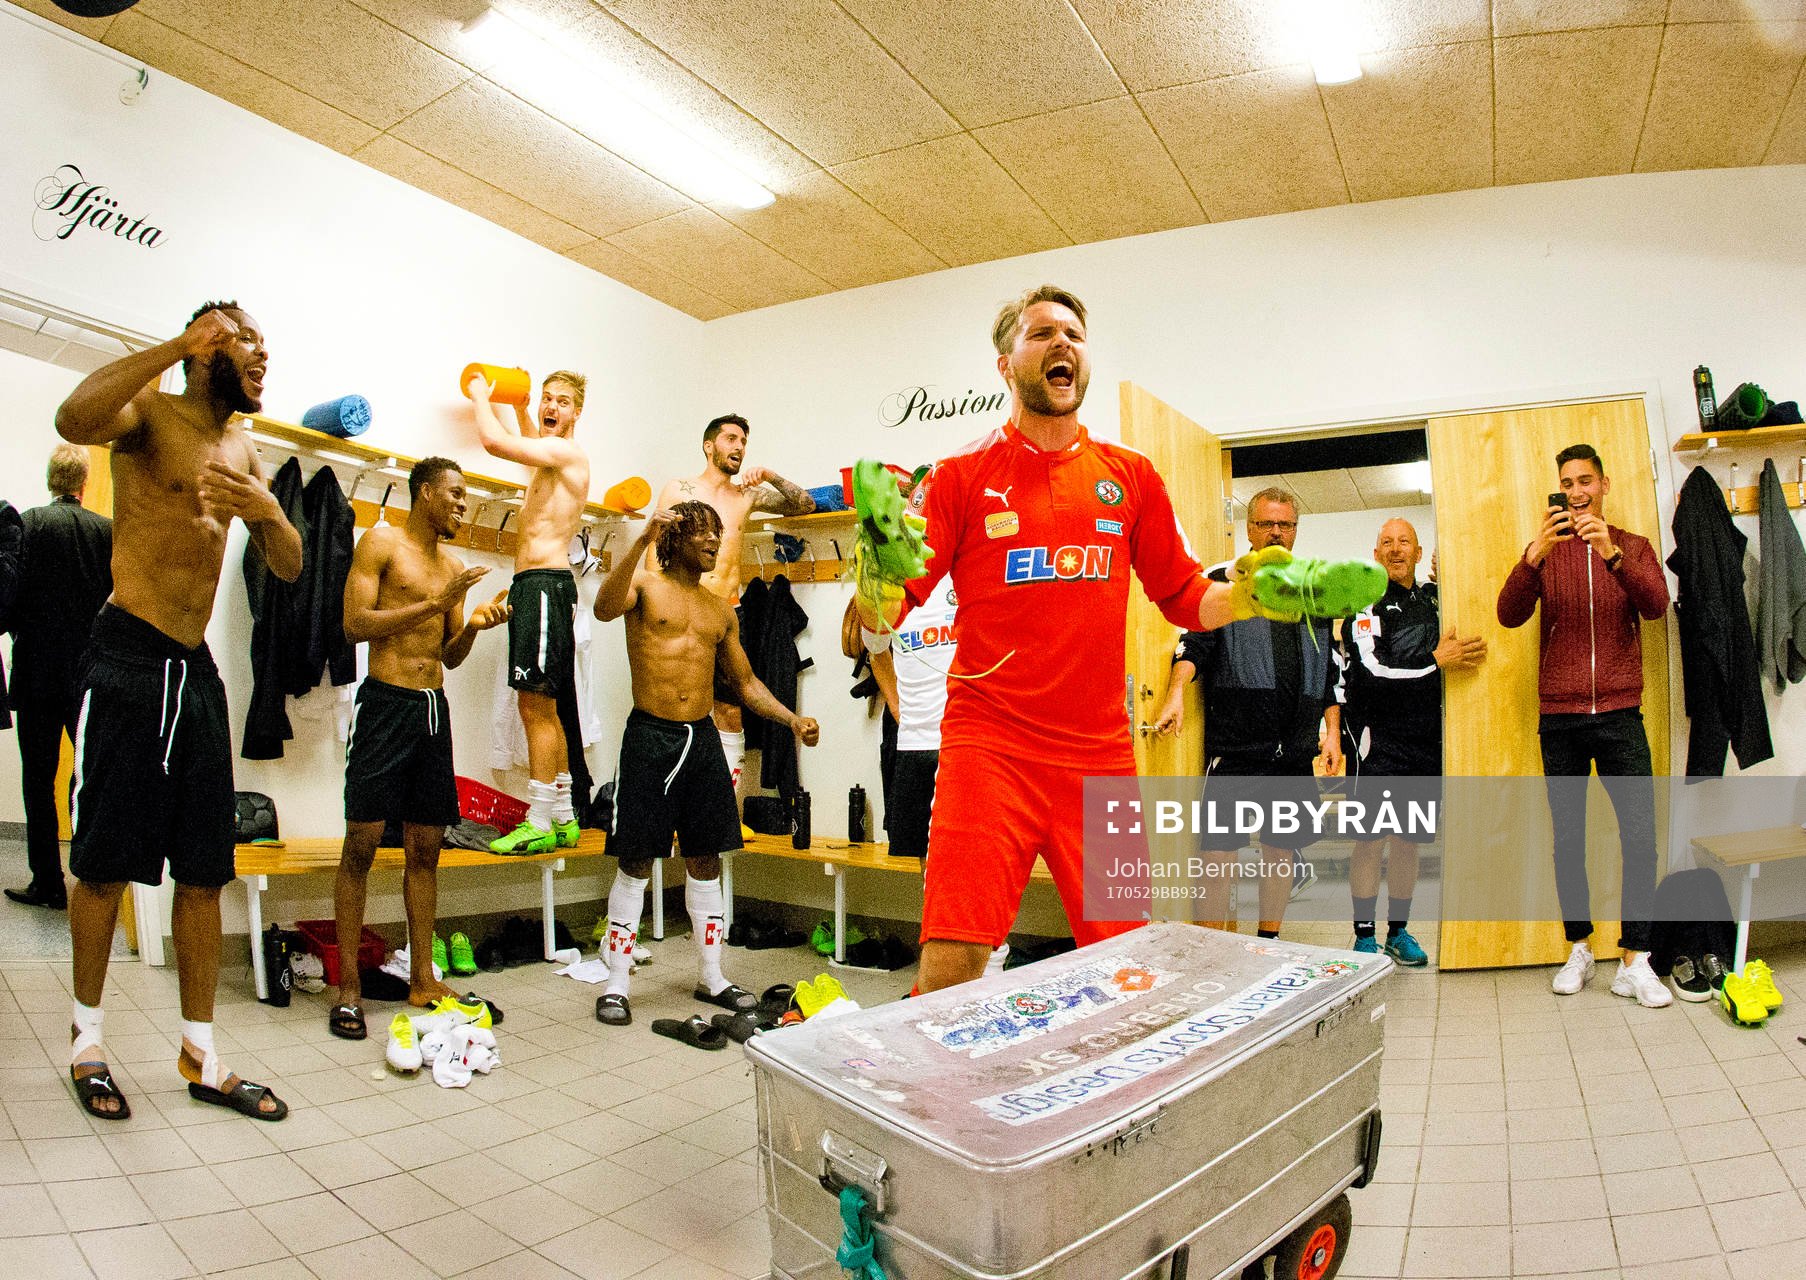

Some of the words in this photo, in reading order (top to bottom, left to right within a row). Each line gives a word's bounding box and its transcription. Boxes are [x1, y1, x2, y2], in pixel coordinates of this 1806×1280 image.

[33, 164, 168, 249] Hjärta
[878, 385, 1010, 428] Passion
[1005, 545, 1112, 584] ELON
[899, 625, 957, 651] ELON
[1122, 1012, 1256, 1066] Sports
